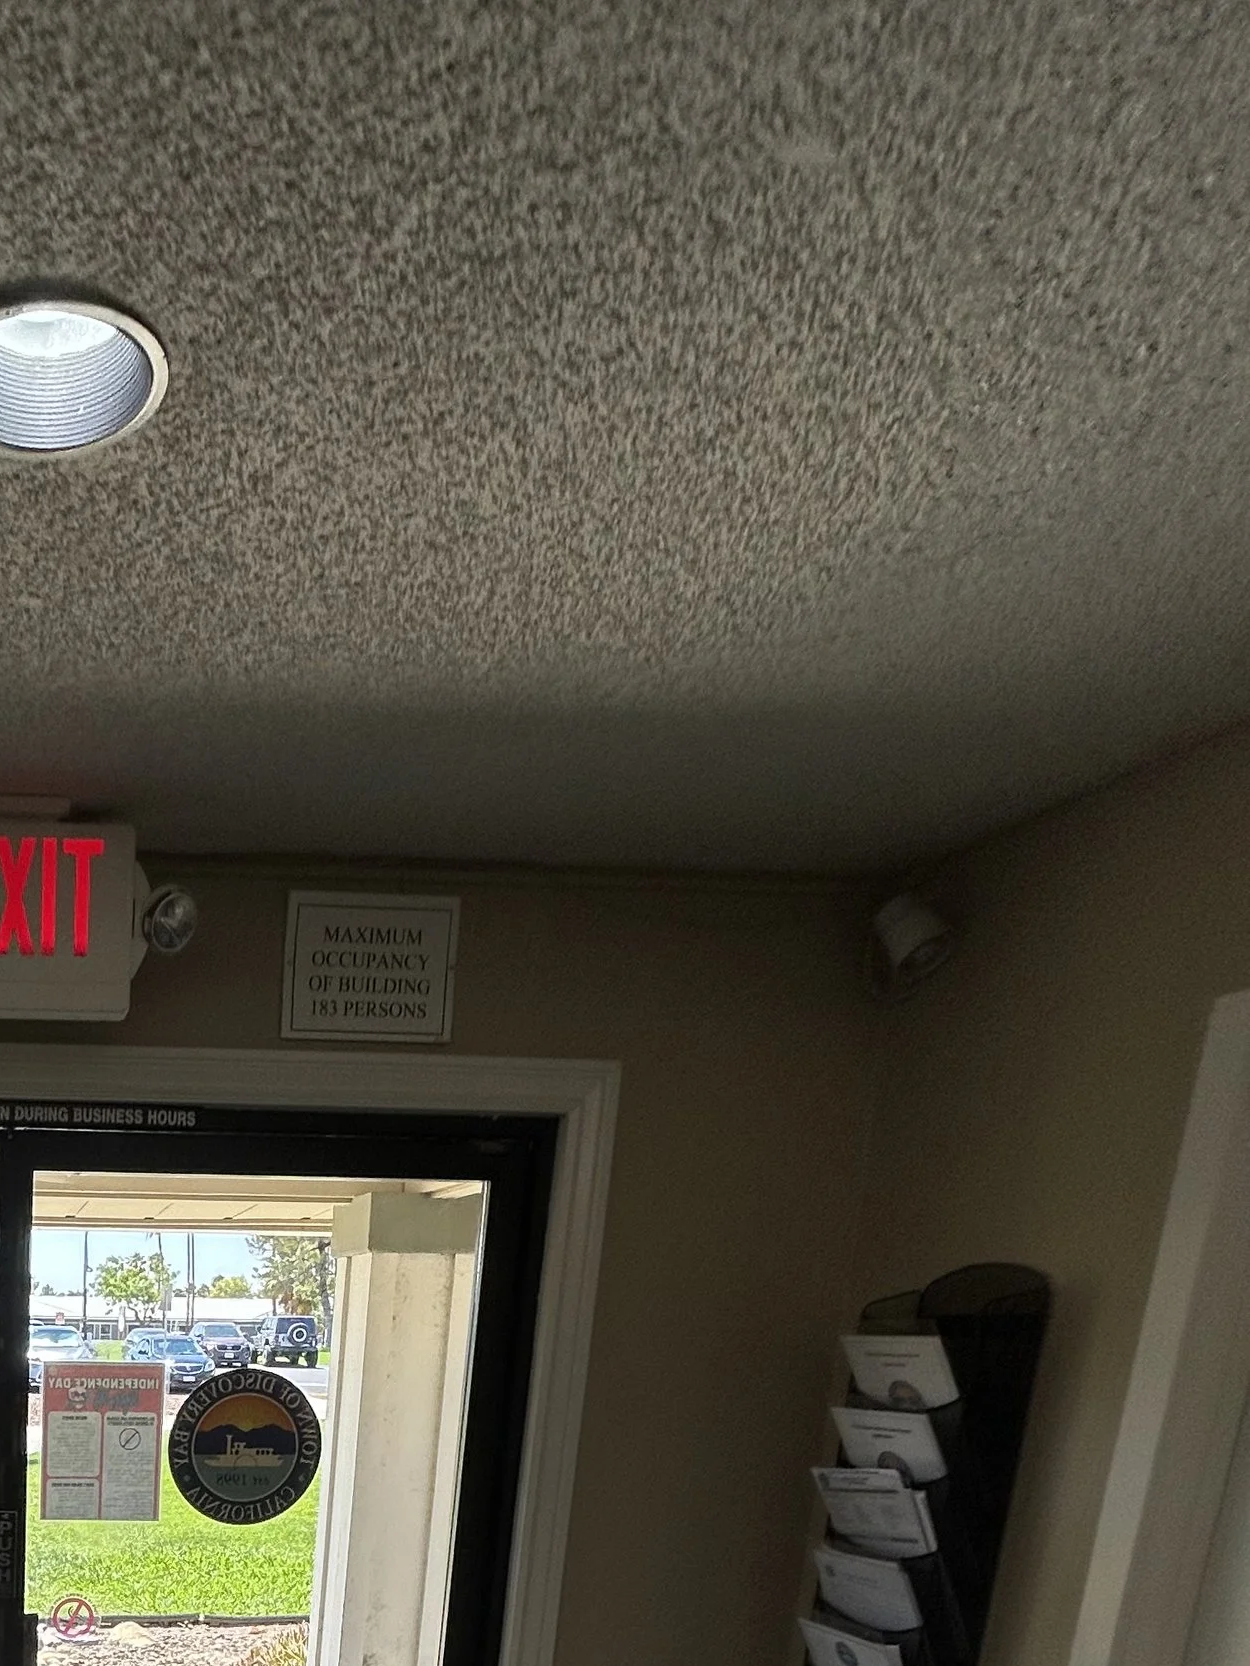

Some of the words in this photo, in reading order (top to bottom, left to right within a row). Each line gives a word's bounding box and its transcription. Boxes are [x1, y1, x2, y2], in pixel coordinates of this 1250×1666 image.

[323, 925, 422, 947] MAXIMUM
[311, 949, 430, 971] OCCUPANCY
[308, 975, 332, 993] OF
[338, 976, 430, 995] BUILDING
[311, 999, 337, 1016] 183
[343, 1000, 427, 1019] PERSONS
[14, 1105, 69, 1123] DURING
[73, 1107, 144, 1125] BUSINESS
[147, 1109, 196, 1127] HOURS
